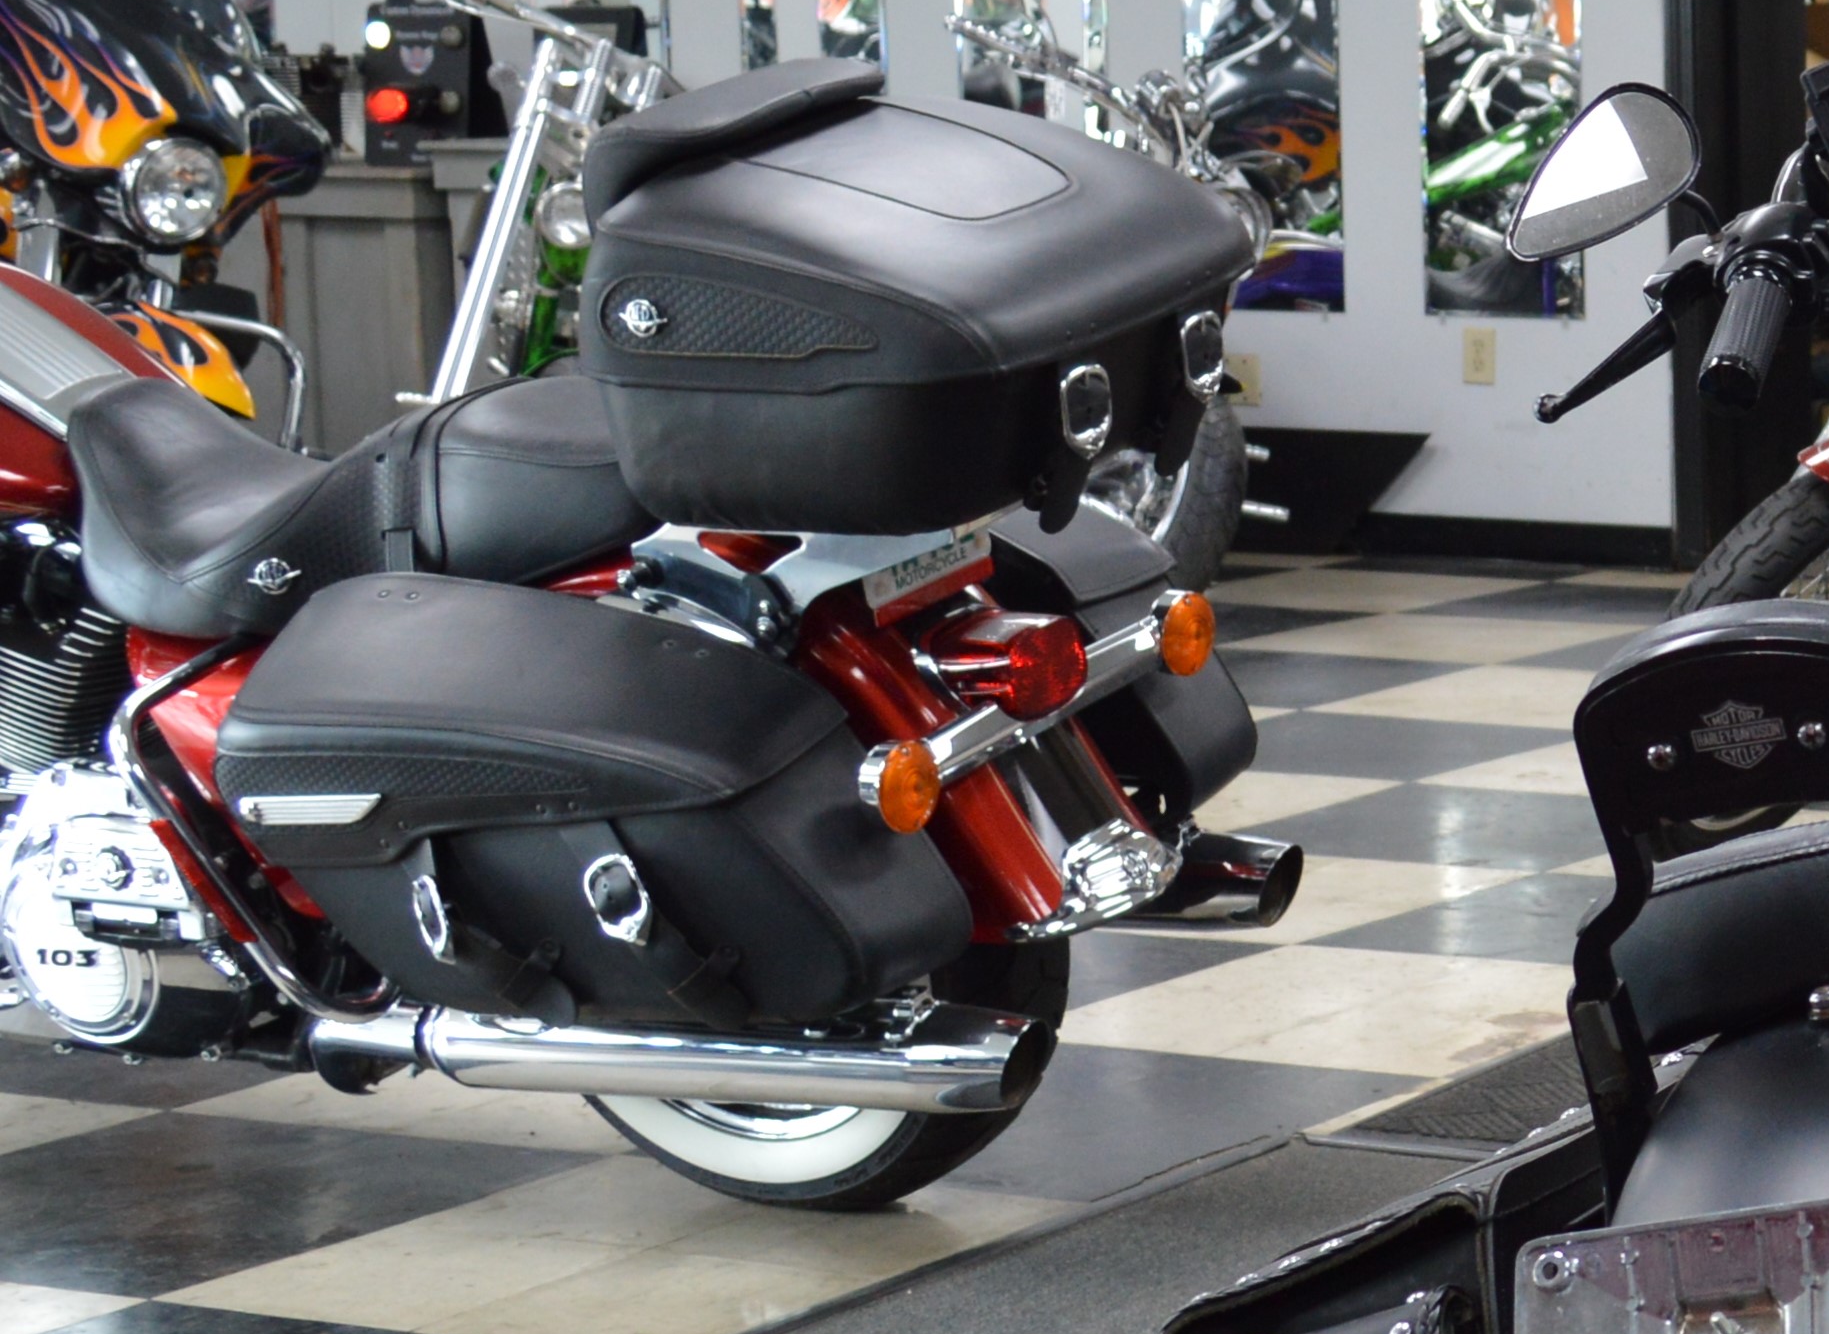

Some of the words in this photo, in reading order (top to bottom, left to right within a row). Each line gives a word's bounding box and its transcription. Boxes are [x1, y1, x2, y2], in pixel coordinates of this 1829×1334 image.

[896, 546, 967, 590] MOTORCYCLE
[1711, 707, 1757, 726] MOTOR
[1695, 723, 1781, 748] HARLEY-DAVIDSON
[1721, 744, 1766, 766] CYCLES
[37, 948, 98, 967] 103
